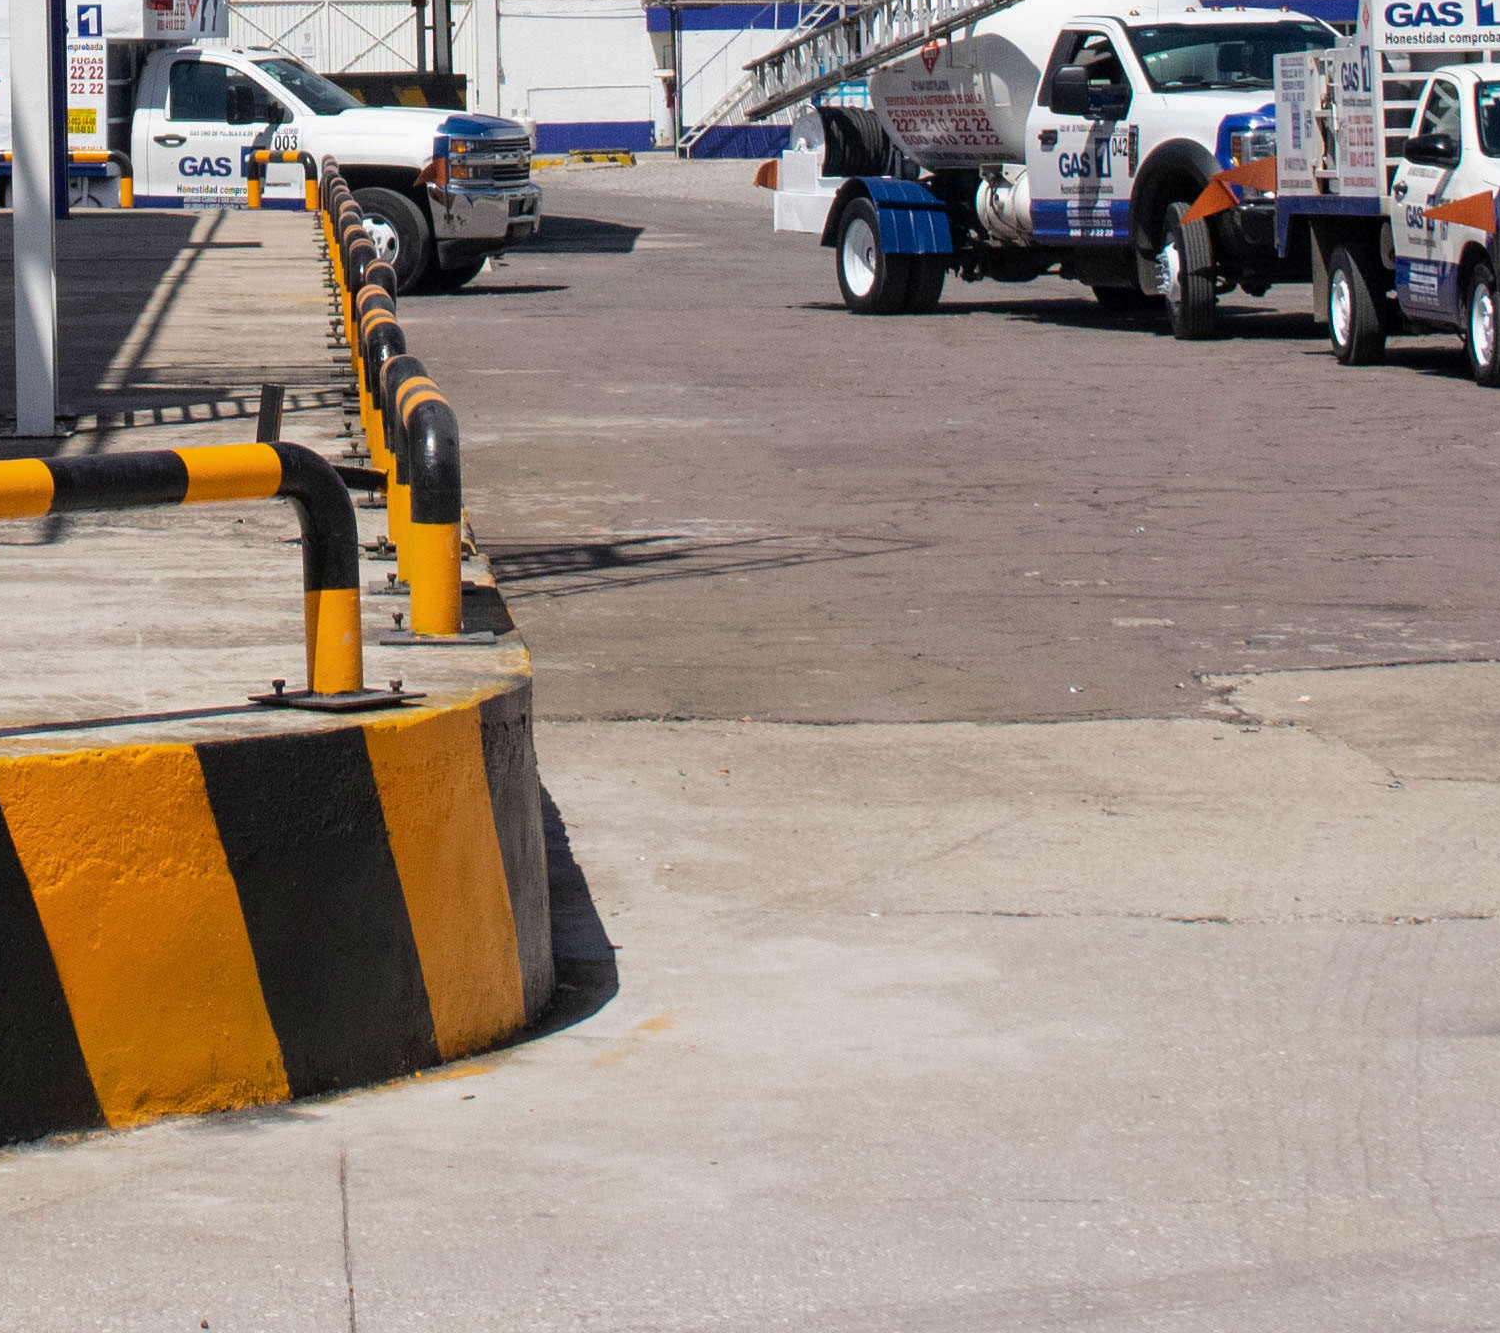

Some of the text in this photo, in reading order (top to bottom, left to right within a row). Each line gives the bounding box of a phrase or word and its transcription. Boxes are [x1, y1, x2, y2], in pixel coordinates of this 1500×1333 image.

[80, 6, 98, 35] 1
[1384, 2, 1464, 27] GAS
[1385, 31, 1445, 44] Honestidad
[68, 42, 103, 52] mprobada
[71, 57, 104, 65] FUGAS
[70, 66, 104, 80] 22 22
[1341, 62, 1359, 92] GAS
[70, 84, 104, 94] 22 22
[887, 109, 935, 117] PEDIDOS
[948, 108, 986, 117] FUGAS
[892, 118, 994, 132] 222 210 22 22
[275, 135, 297, 150] 003
[932, 135, 958, 145] 410
[960, 135, 981, 145] 22
[981, 135, 1003, 145] 22
[1059, 138, 1127, 178] GAS 1 042
[179, 156, 232, 176] GAS
[177, 184, 248, 195] Honestidad compro
[1406, 204, 1424, 229] GAS
